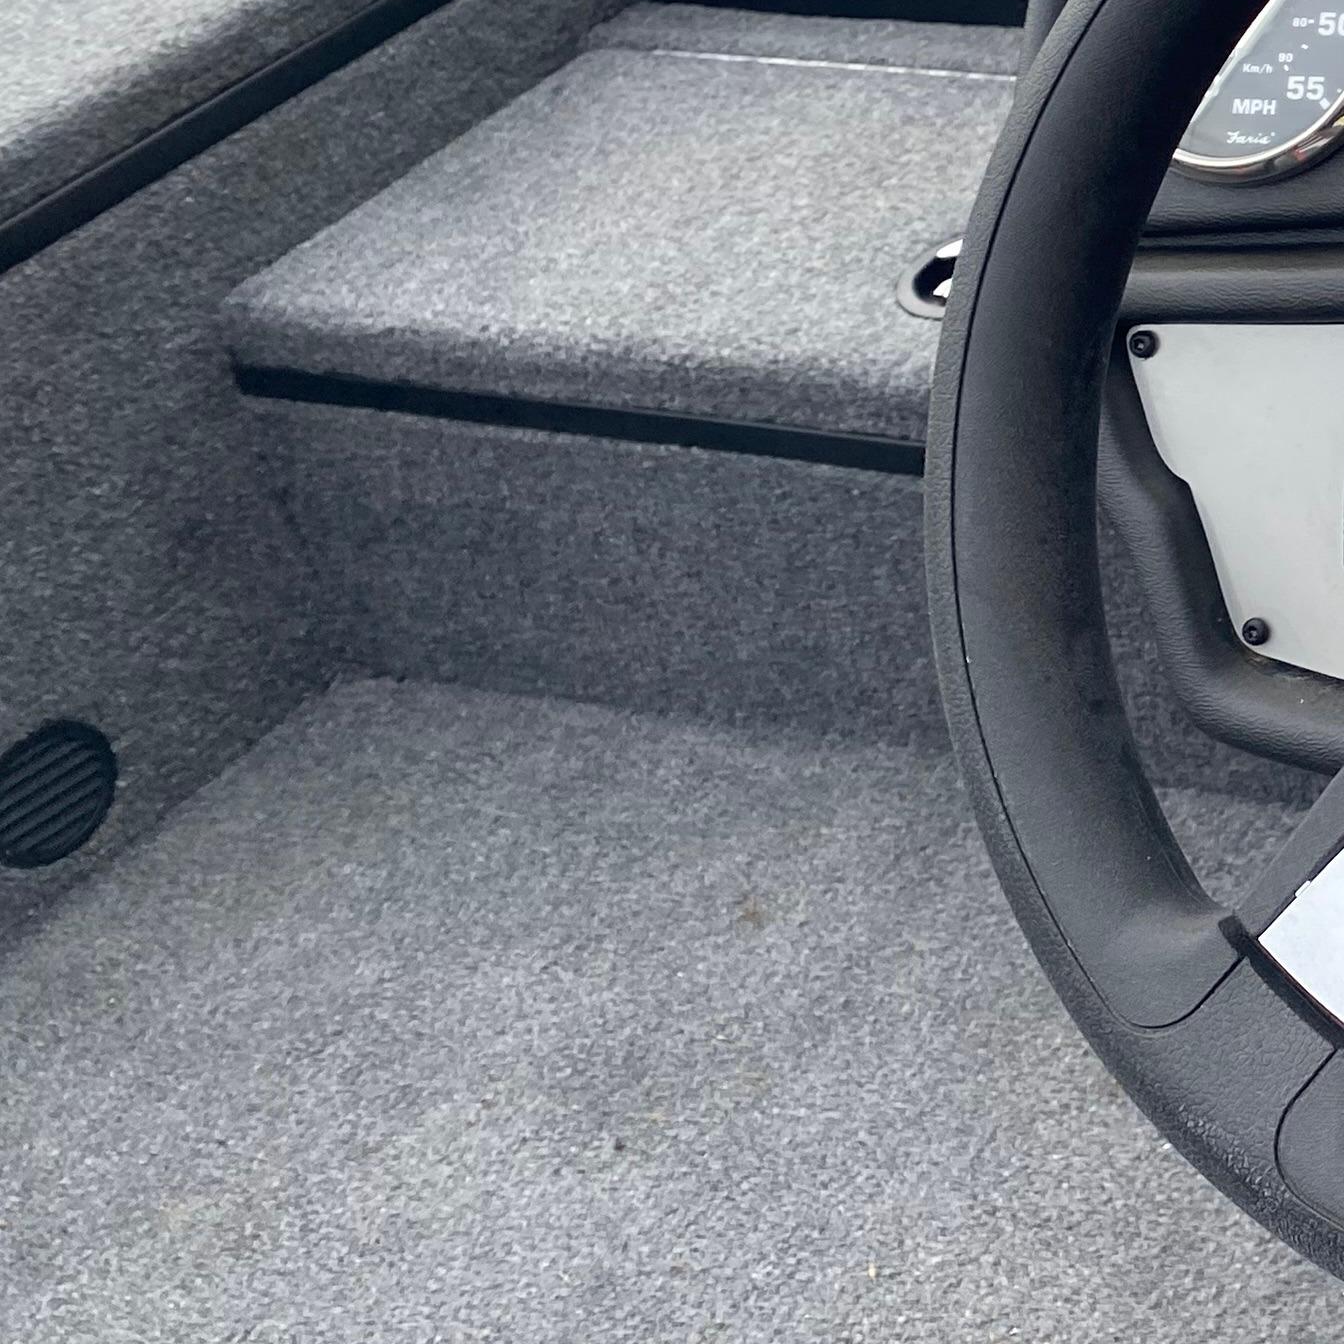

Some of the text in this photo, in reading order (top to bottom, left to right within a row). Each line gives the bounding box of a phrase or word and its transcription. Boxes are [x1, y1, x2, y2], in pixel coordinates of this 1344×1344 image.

[1292, 17, 1308, 27] 80
[1242, 63, 1273, 74] Km/h
[1286, 76, 1325, 100] 55
[1232, 98, 1277, 115] MPH
